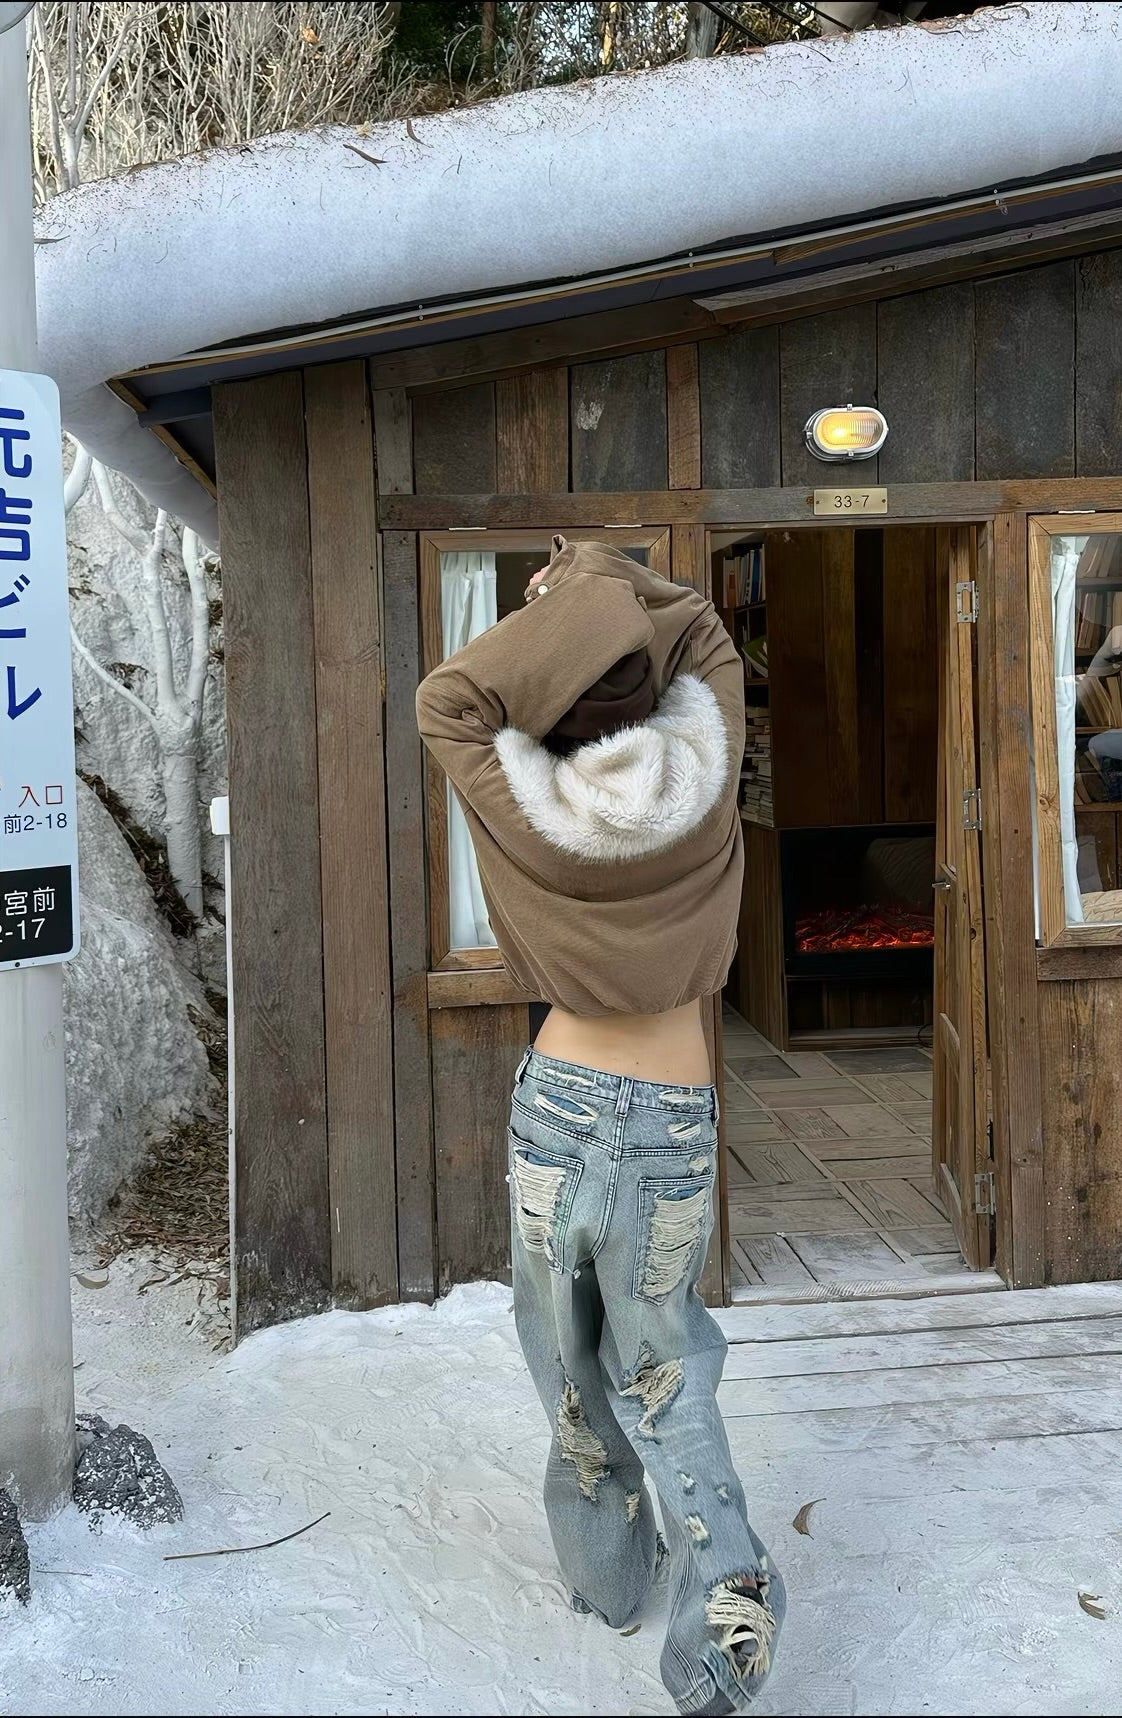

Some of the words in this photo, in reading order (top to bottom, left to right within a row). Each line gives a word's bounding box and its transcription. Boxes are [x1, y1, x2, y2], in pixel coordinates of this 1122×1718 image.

[834, 495, 870, 508] 33-7
[18, 785, 63, 808] 入口
[3, 812, 68, 835] 前2-18
[4, 886, 56, 916] 宮前
[0, 918, 46, 943] -17
